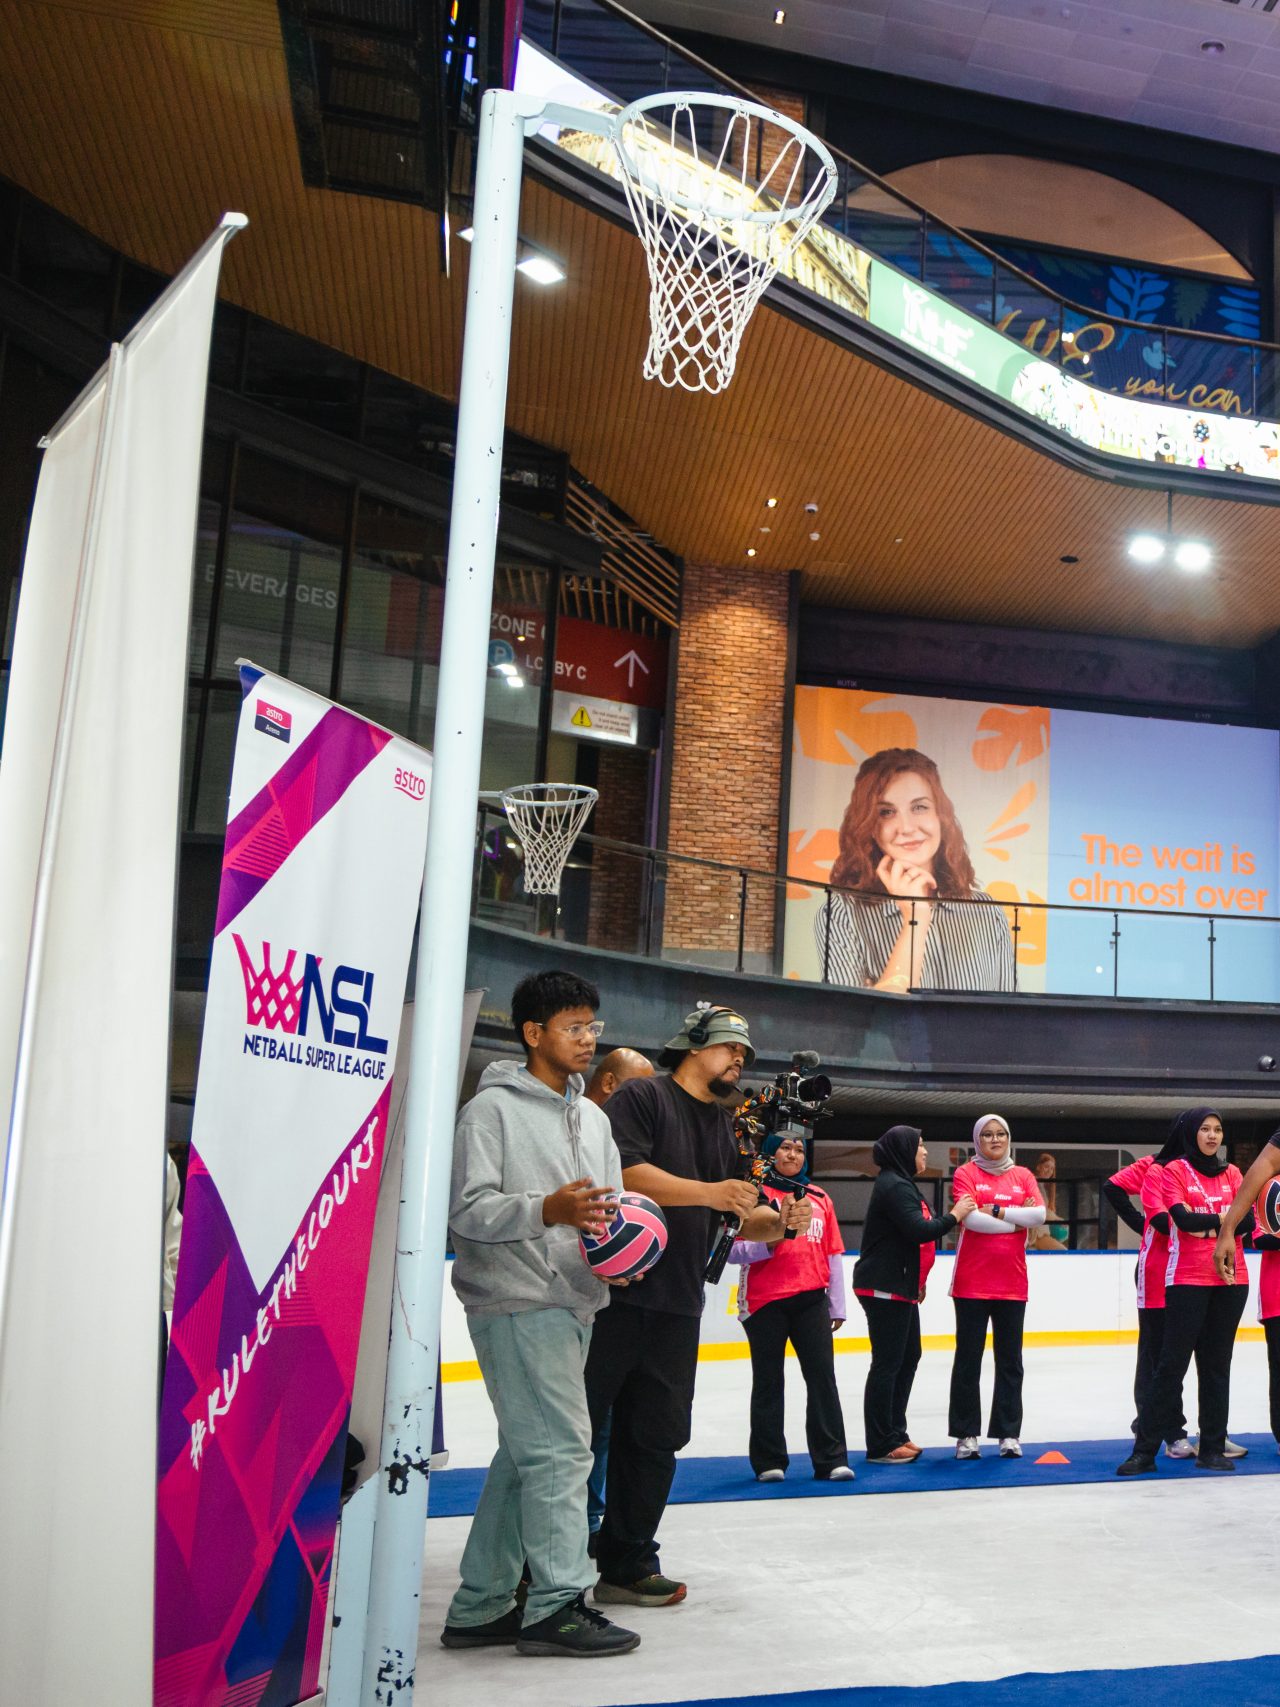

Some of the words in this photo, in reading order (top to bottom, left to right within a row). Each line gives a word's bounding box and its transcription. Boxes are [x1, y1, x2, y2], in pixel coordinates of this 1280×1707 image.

[1126, 376, 1187, 402] you
[489, 612, 536, 640] ZONE
[576, 664, 588, 681] C
[265, 707, 283, 722] astro
[394, 766, 426, 796] astro
[1080, 832, 1143, 868] The
[1151, 841, 1225, 874] wait
[1231, 843, 1256, 876] is
[1067, 871, 1188, 908] almost
[1195, 884, 1269, 912] over
[243, 1032, 303, 1065] NETBALL
[305, 1045, 336, 1073] SUPER
[337, 1052, 387, 1081] LEAGUE
[190, 1116, 379, 1472] #RULETHECOURT
